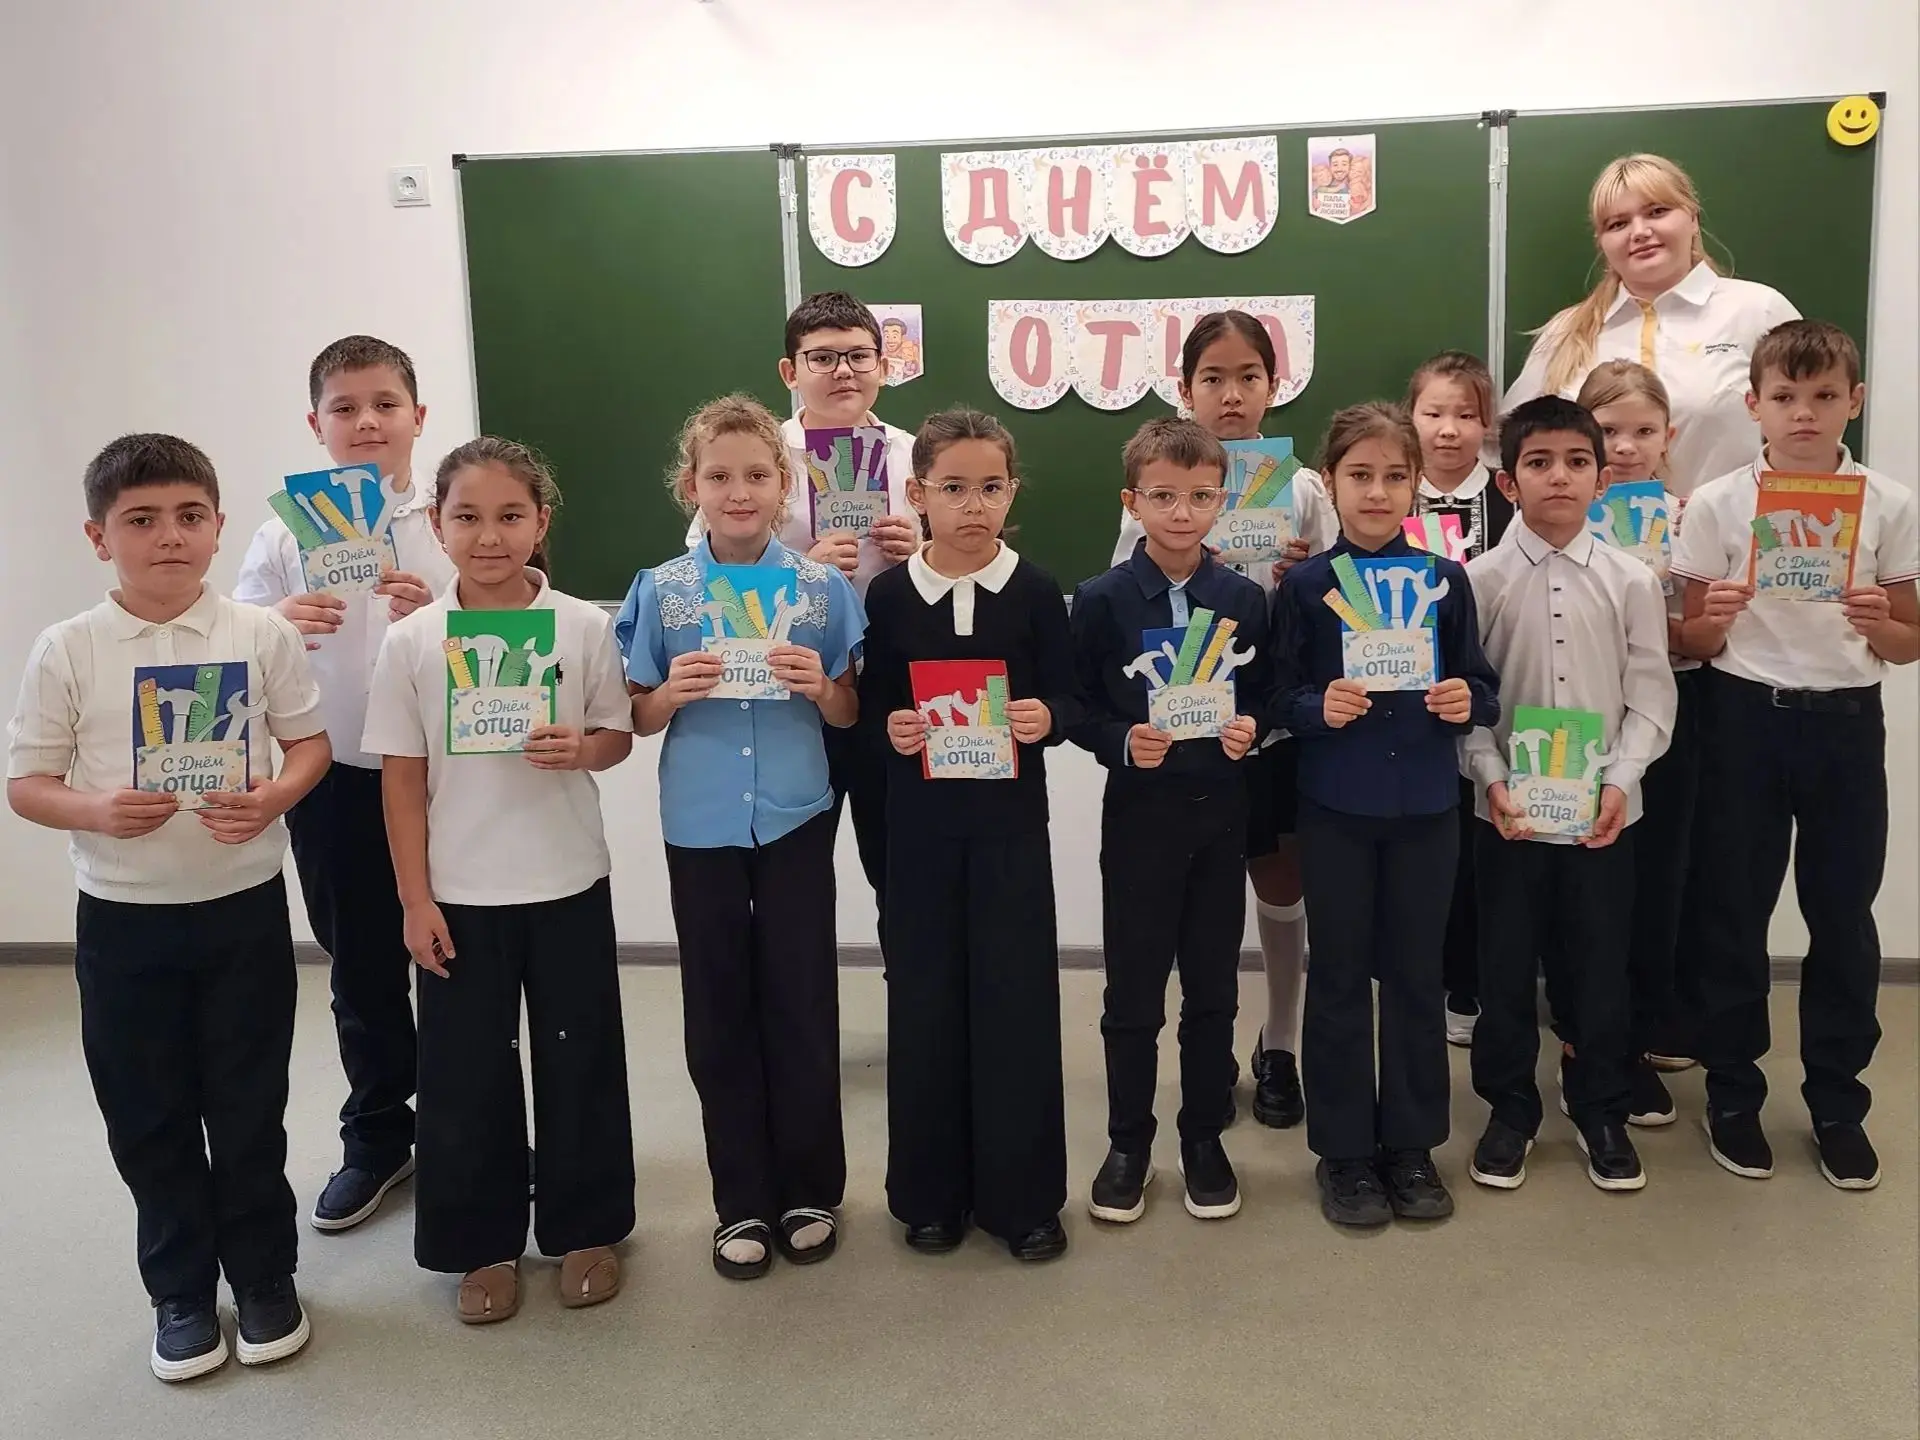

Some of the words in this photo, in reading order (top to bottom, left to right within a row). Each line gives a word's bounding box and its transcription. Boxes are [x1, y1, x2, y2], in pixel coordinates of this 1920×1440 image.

[830, 168, 875, 243] С
[958, 154, 1266, 244] ДНЁМ
[830, 501, 840, 514] С
[842, 500, 874, 512] Днём
[1229, 520, 1238, 532] С
[1242, 520, 1276, 532] Днём
[322, 554, 334, 568] С
[337, 548, 376, 564] Днём
[1775, 556, 1786, 569] С
[1790, 556, 1830, 568] Днём
[720, 650, 731, 664] С
[1362, 644, 1374, 658] С
[1376, 642, 1416, 657] Днём
[472, 700, 484, 716] С
[488, 698, 531, 715] Днём
[1168, 698, 1178, 712] С
[1180, 696, 1218, 709] Днём
[944, 736, 954, 748] С
[958, 736, 995, 748] Днём
[161, 757, 174, 774] С
[179, 756, 225, 772] Днём
[1528, 788, 1539, 801] С
[1541, 788, 1578, 802] Днём
